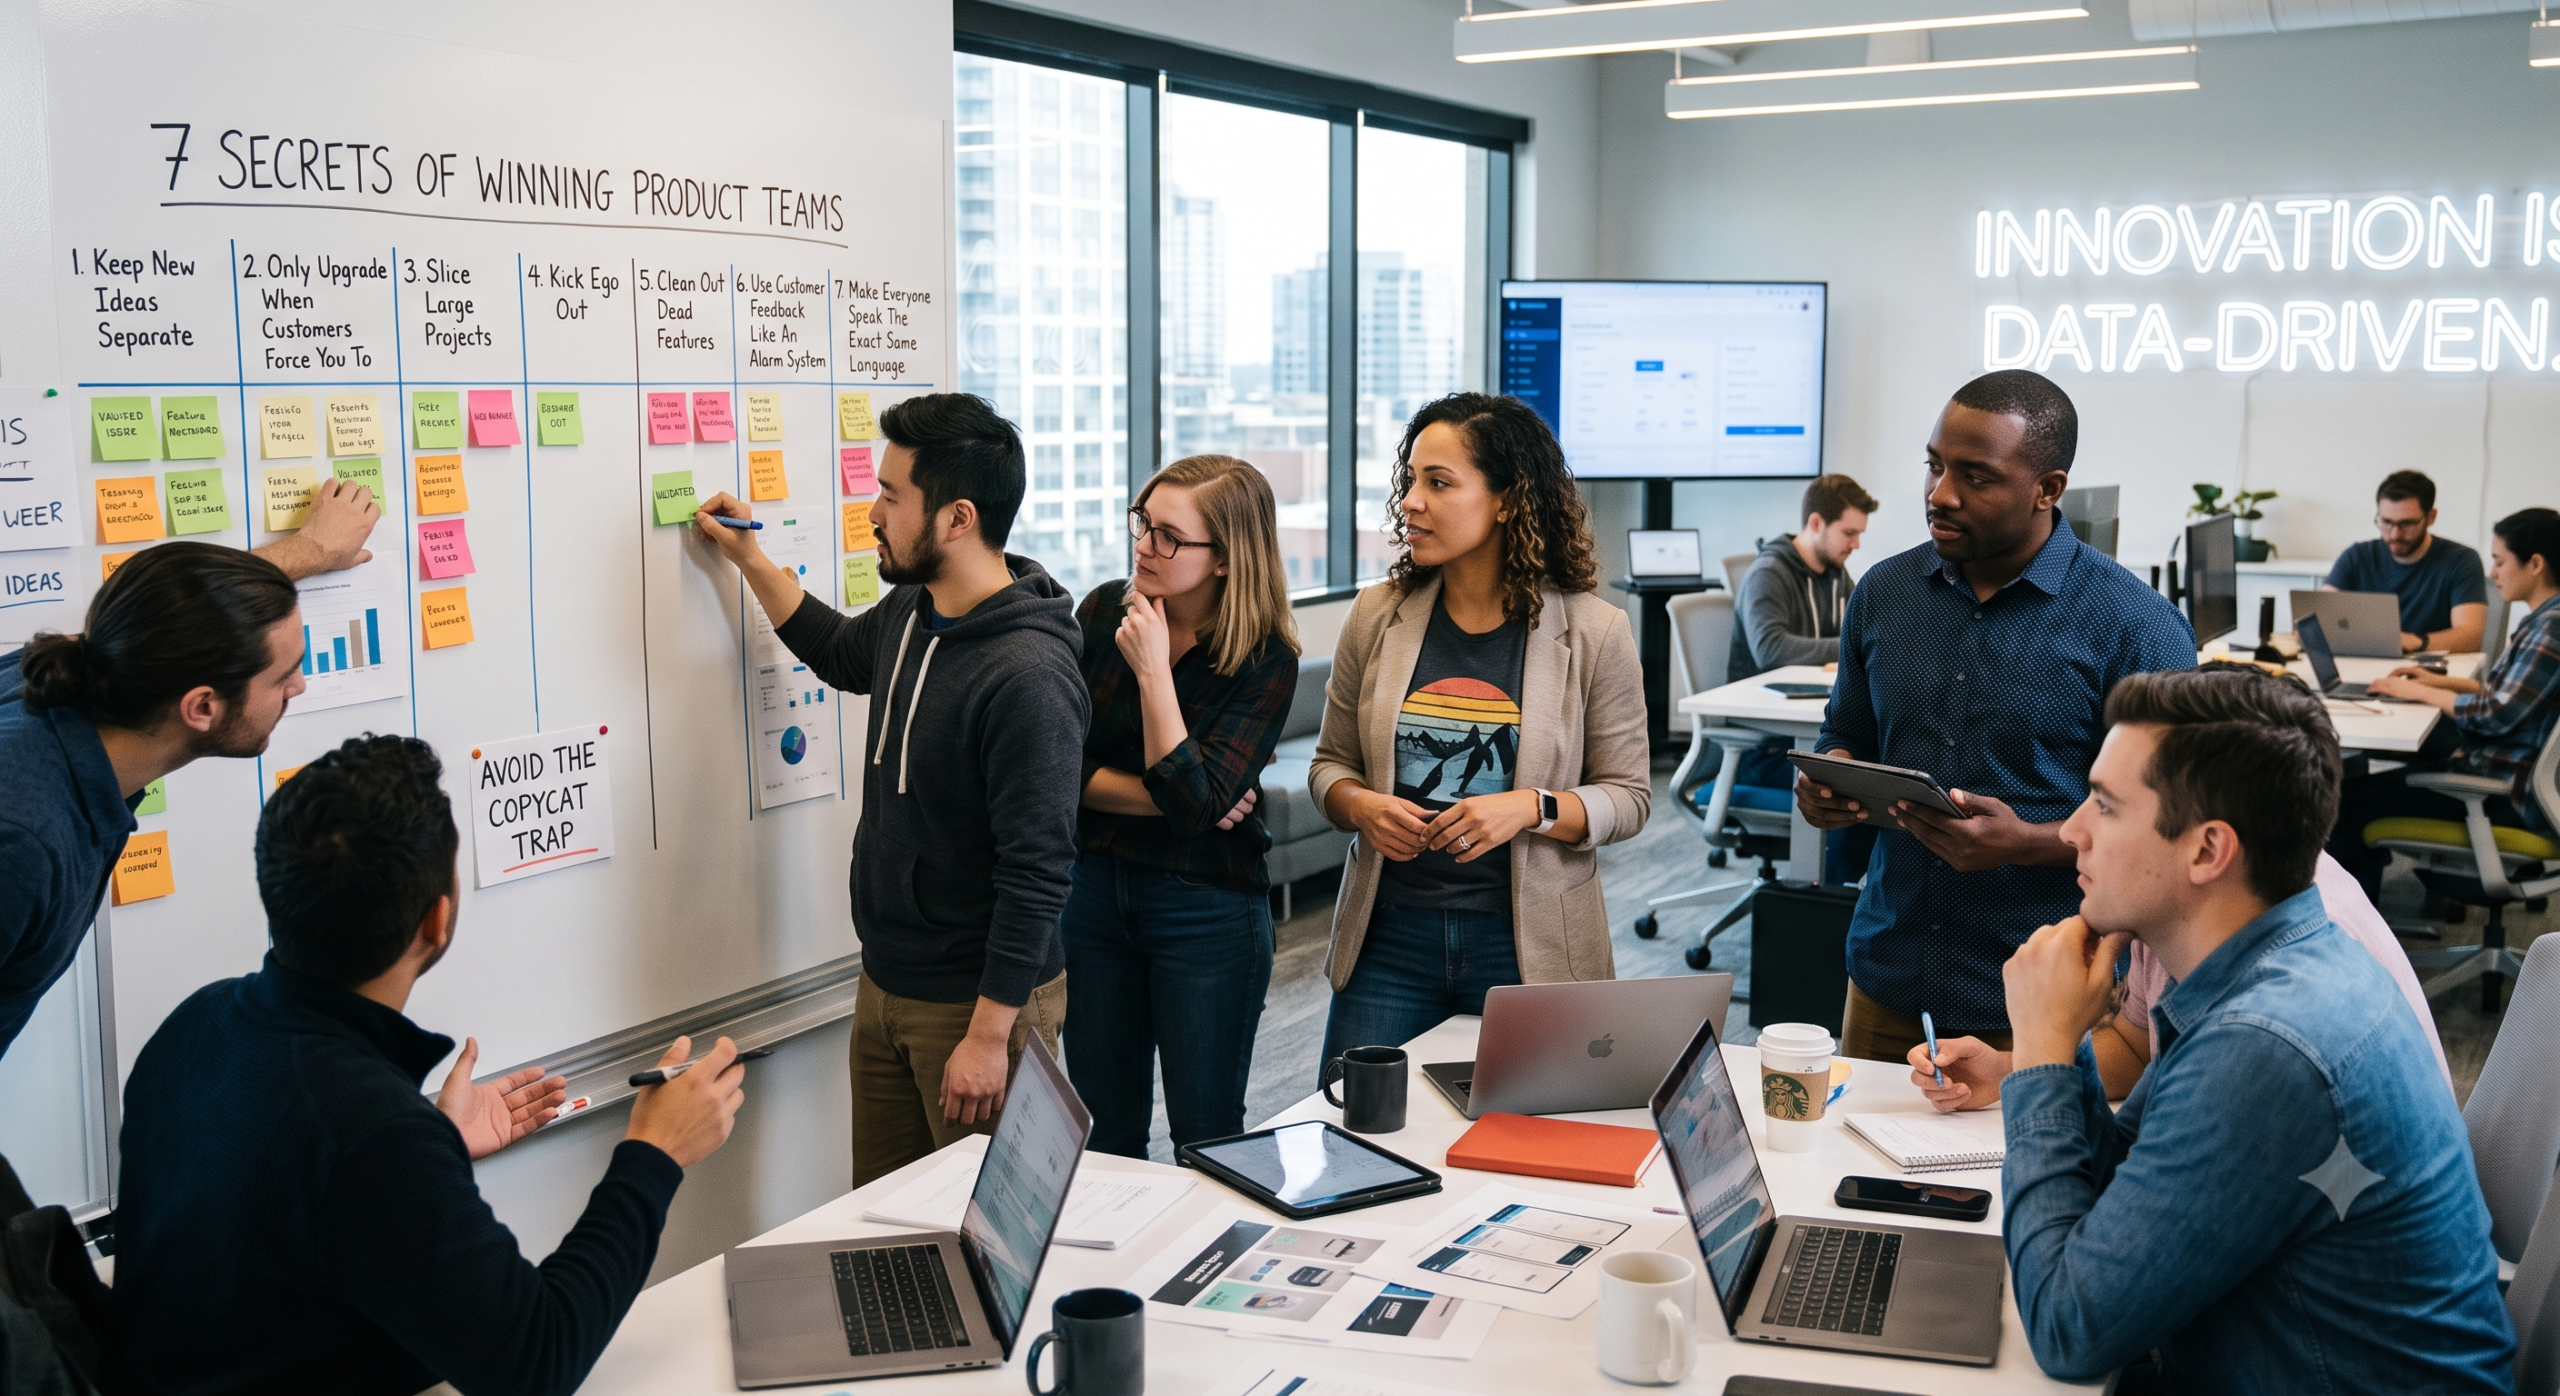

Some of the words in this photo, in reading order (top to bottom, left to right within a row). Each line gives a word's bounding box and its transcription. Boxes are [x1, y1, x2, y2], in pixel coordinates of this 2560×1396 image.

[151, 124, 190, 190] 7
[219, 130, 392, 194] SECRETS
[417, 153, 456, 197] OF
[476, 156, 613, 211] WINNING
[634, 170, 748, 221] PRODUCT
[762, 187, 843, 231] TEAMS
[1975, 193, 2494, 278] INNOVATION
[73, 249, 83, 275] 1.
[94, 248, 143, 283] Keep
[153, 250, 194, 276] New
[244, 254, 261, 278] 2.
[268, 254, 310, 287] Only
[318, 255, 387, 287] Upgrade
[405, 259, 420, 283] 3.
[427, 258, 470, 284] Slice
[527, 264, 544, 289] 4.
[550, 264, 584, 288] Kick
[591, 266, 620, 298] Ego
[640, 270, 653, 290] 5.
[658, 270, 695, 291] Clean
[701, 272, 724, 292] Out
[736, 275, 749, 293] 6.
[752, 274, 772, 293] Use
[775, 275, 826, 296] Customer
[834, 279, 845, 299] 7.
[850, 281, 878, 299] Make
[882, 282, 931, 307] Everyone
[95, 287, 158, 312] Ideas
[262, 289, 313, 309] When
[425, 291, 475, 323] Large
[557, 298, 588, 319] Out
[658, 299, 692, 319] Dead
[751, 299, 804, 317] Feedback
[263, 318, 352, 338] Customers
[849, 305, 882, 328] Speak
[888, 308, 908, 326] The
[99, 322, 193, 356] Separate
[426, 323, 491, 354] Projects
[658, 328, 714, 349] Features
[751, 325, 775, 342] Like
[782, 324, 796, 342] An
[850, 331, 881, 348] Exact
[887, 331, 916, 350] Same
[266, 348, 310, 369] Force
[316, 347, 345, 367] You
[351, 346, 371, 366] To
[750, 349, 783, 366] Alarm
[786, 353, 827, 374] System
[850, 355, 905, 380] Language
[3, 501, 63, 528] WEER
[5, 571, 63, 596] IDEAS
[481, 753, 543, 789] AVOID
[553, 742, 596, 773] THE
[489, 778, 588, 832] COPYCAT
[512, 822, 573, 859] TRAP
